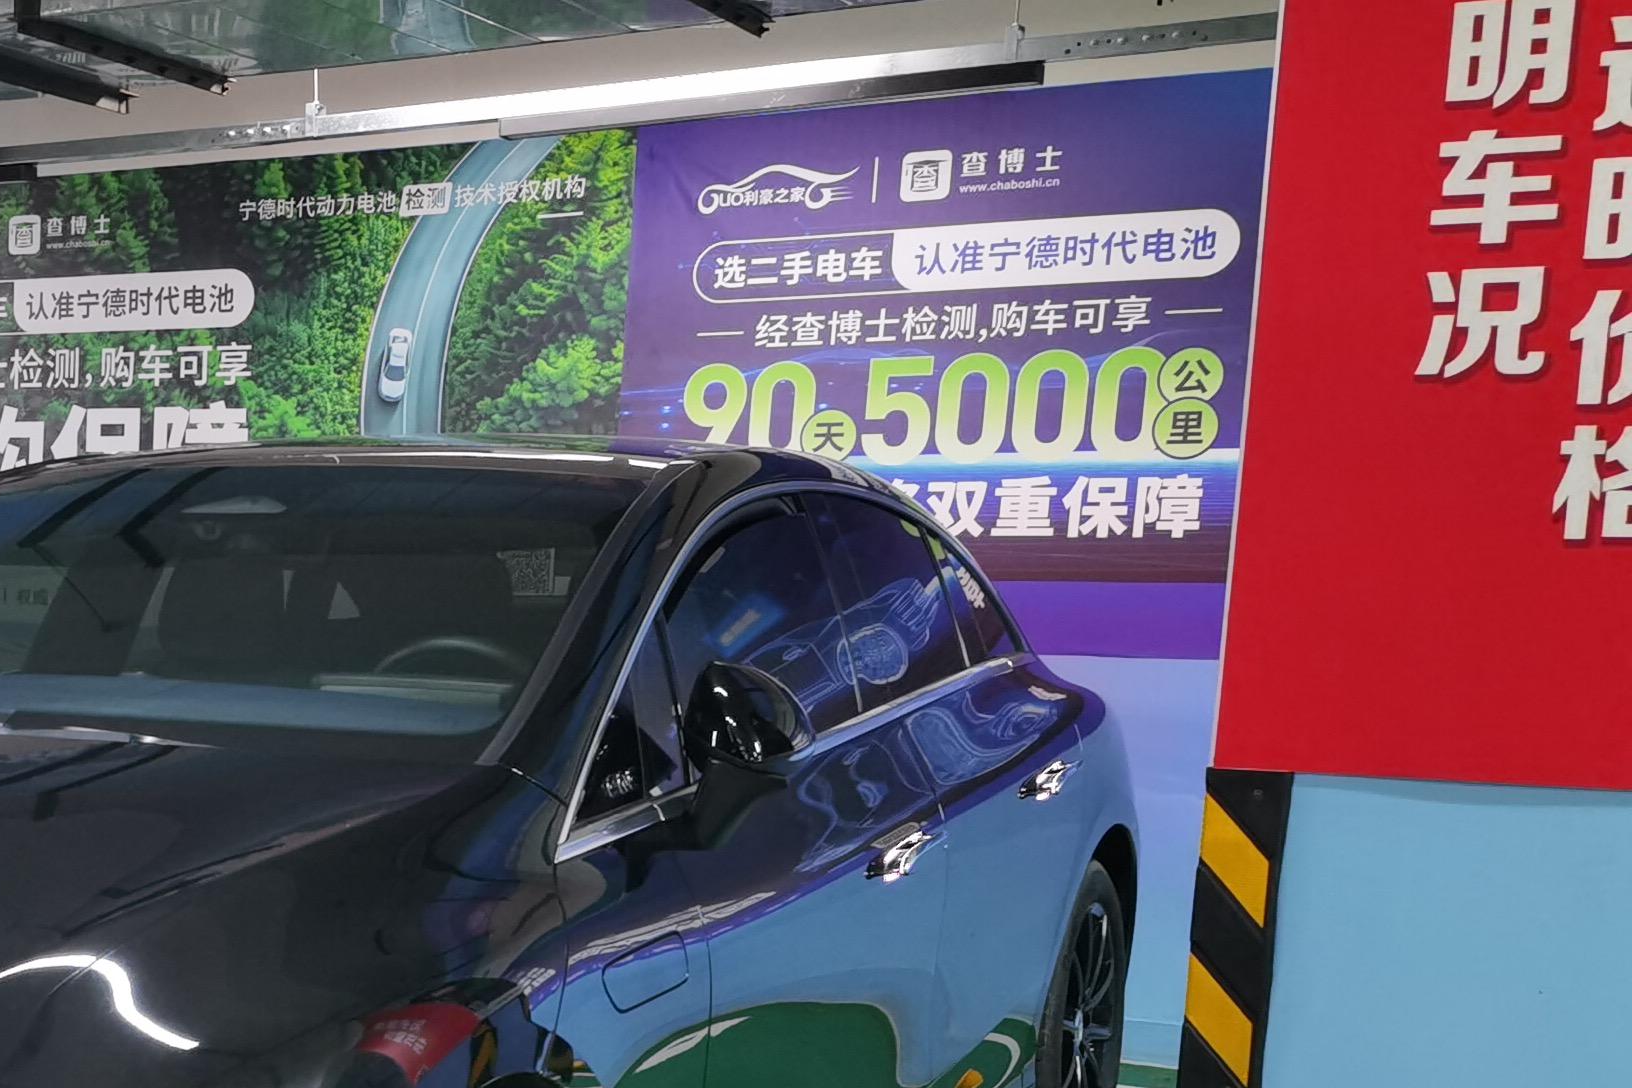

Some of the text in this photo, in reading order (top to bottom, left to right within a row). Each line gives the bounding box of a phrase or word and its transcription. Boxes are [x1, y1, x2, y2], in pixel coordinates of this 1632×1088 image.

[960, 146, 1063, 177] 查博士
[959, 178, 1061, 194] www.chaboshi.cn
[47, 214, 111, 237] 查博士
[713, 225, 1217, 290] 选二手电车 认准宁德时代电池
[26, 283, 235, 321] 认准宁德时代电池
[891, 475, 1204, 539] 双重保障
